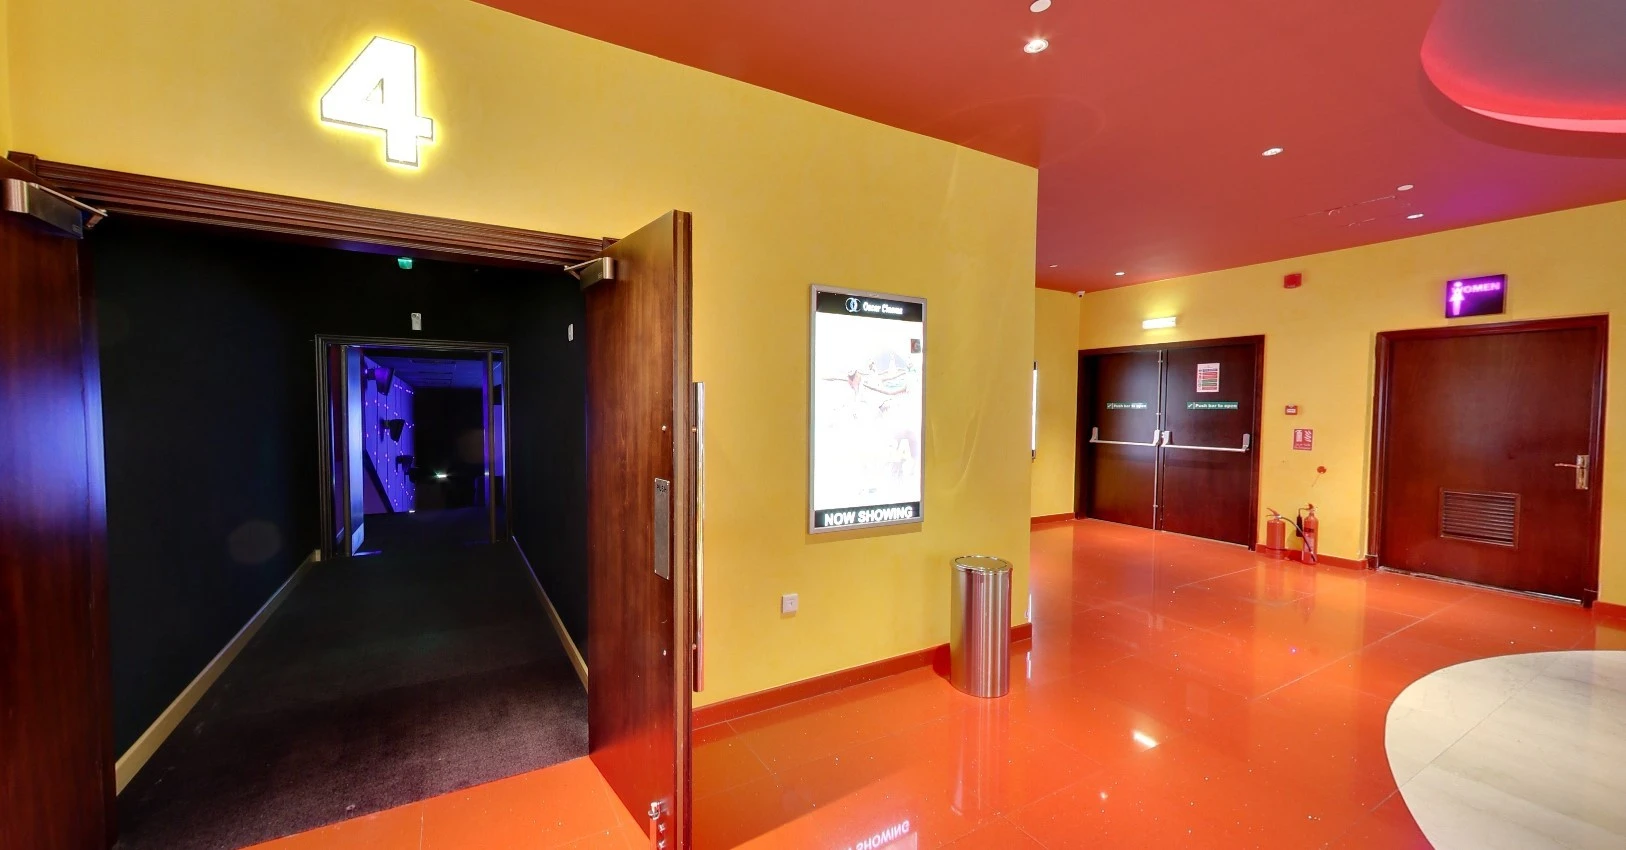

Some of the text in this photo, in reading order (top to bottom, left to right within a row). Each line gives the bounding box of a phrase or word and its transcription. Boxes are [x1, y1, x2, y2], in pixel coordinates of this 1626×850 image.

[320, 36, 433, 167] 4
[824, 506, 912, 526] NOW SHOWING
